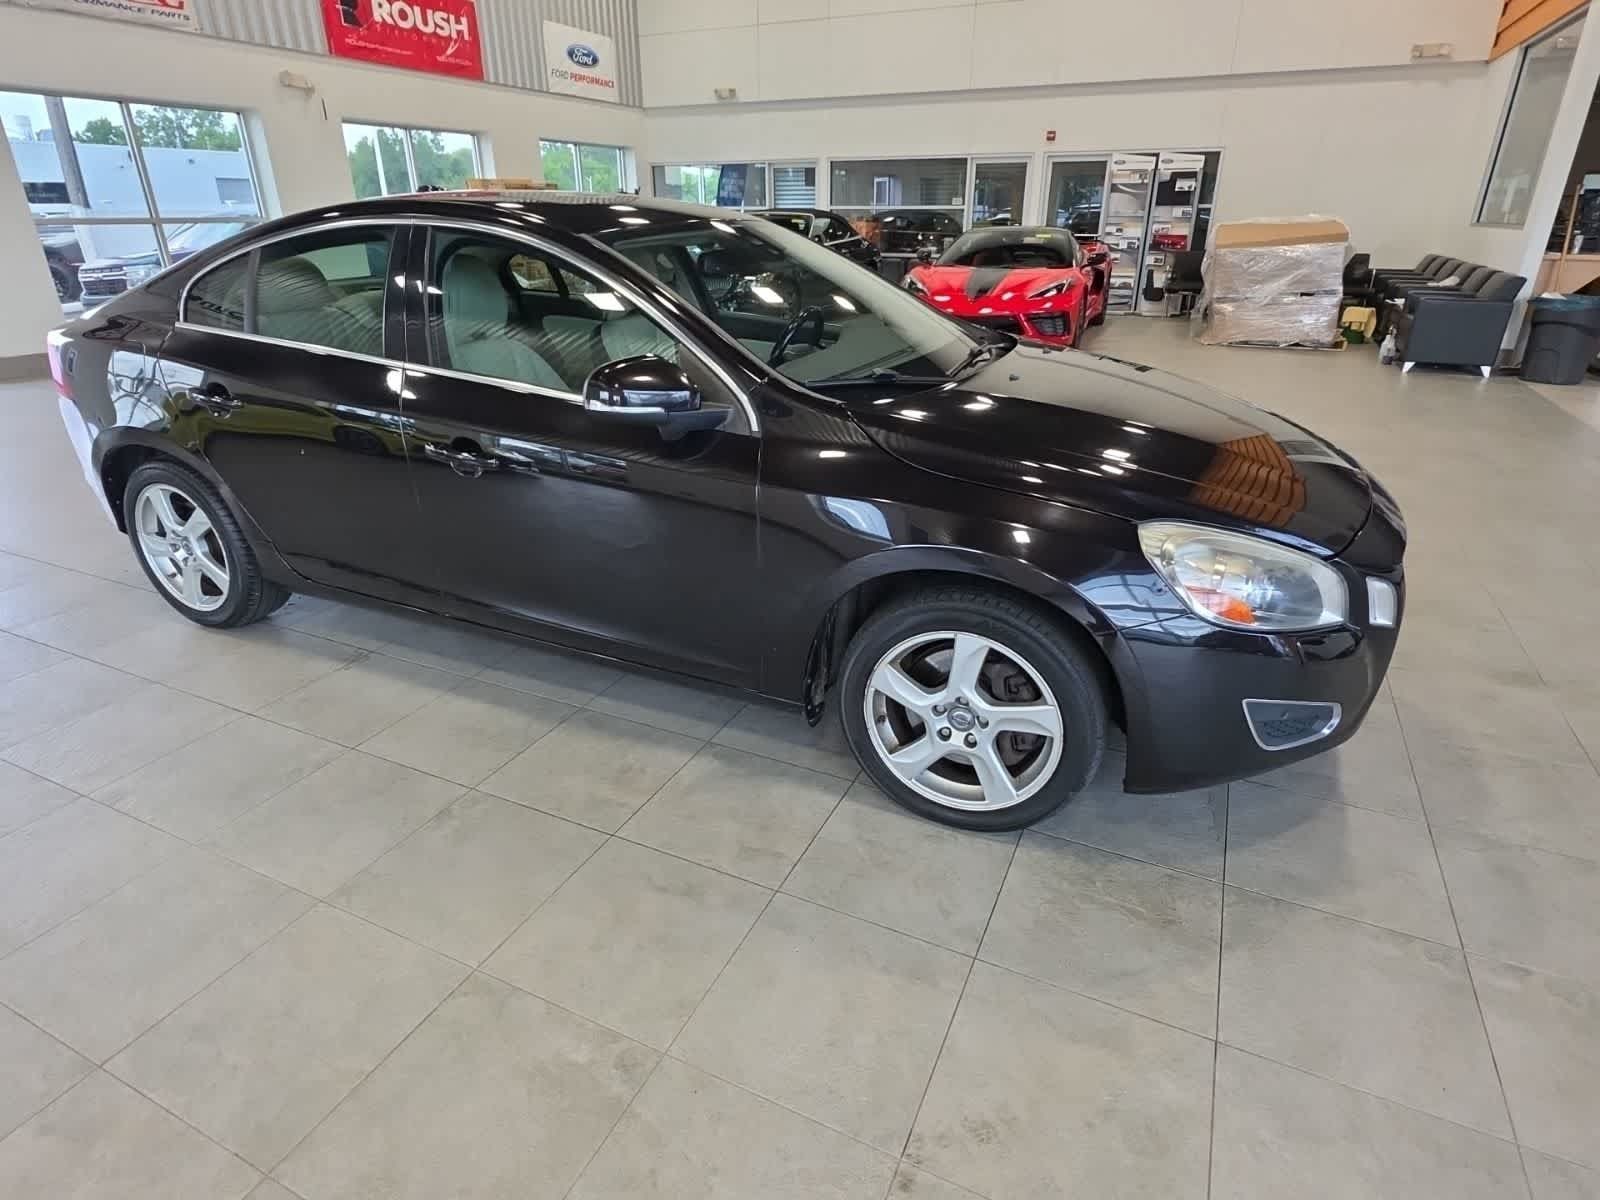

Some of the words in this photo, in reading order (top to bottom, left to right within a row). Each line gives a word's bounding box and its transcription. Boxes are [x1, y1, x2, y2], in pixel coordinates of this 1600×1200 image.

[151, 9, 191, 21] PARTS
[371, 0, 469, 41] ROUSH
[572, 47, 593, 65] Ford
[551, 68, 569, 80] FORD
[569, 72, 615, 89] PERFORMANCE
